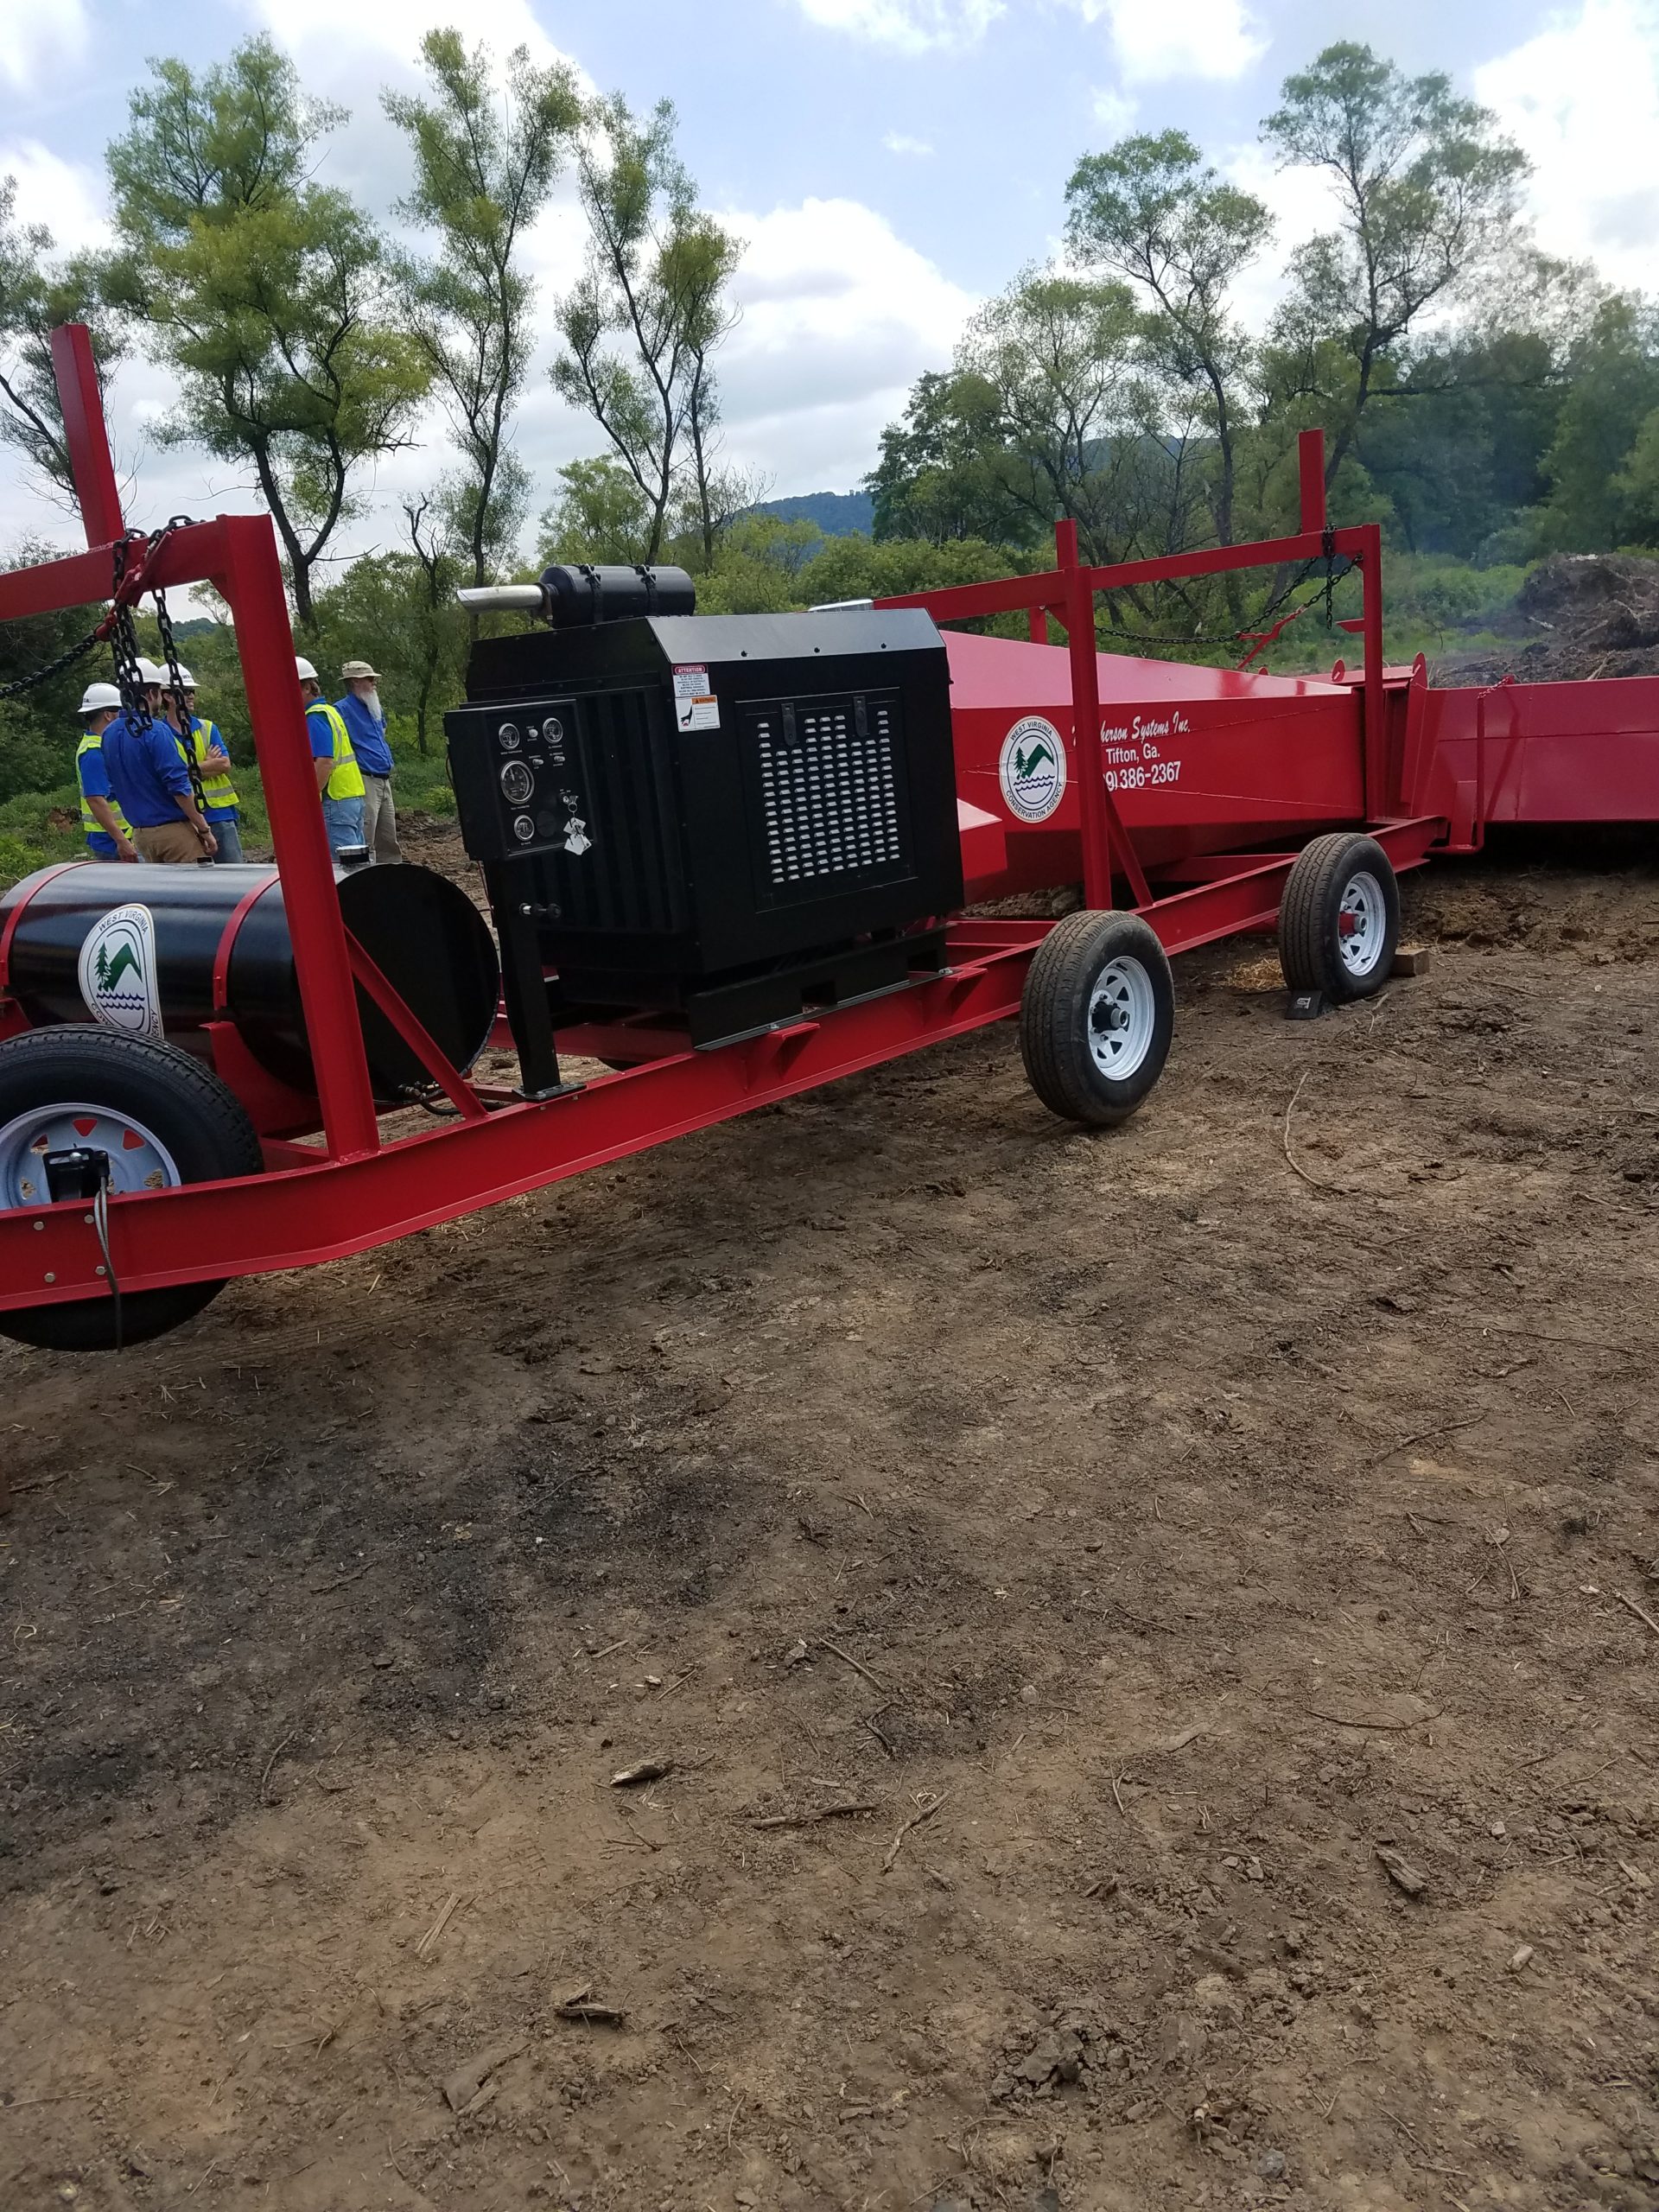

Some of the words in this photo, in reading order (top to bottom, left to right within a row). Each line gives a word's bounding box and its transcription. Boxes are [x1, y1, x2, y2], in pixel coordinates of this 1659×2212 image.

[1010, 723, 1027, 741] WEST
[1027, 721, 1052, 737] VIRGINIA
[1131, 715, 1170, 744] Systems
[1172, 710, 1191, 734] Inc.
[1106, 747, 1140, 765] Tifton,
[1142, 742, 1160, 760] Ga.
[1006, 790, 1046, 819] CONSERVATION
[1046, 782, 1063, 812] AGENCY
[99, 912, 124, 932] WEST
[124, 911, 149, 935] VIRGINIA
[150, 1008, 160, 1037] ENCY
